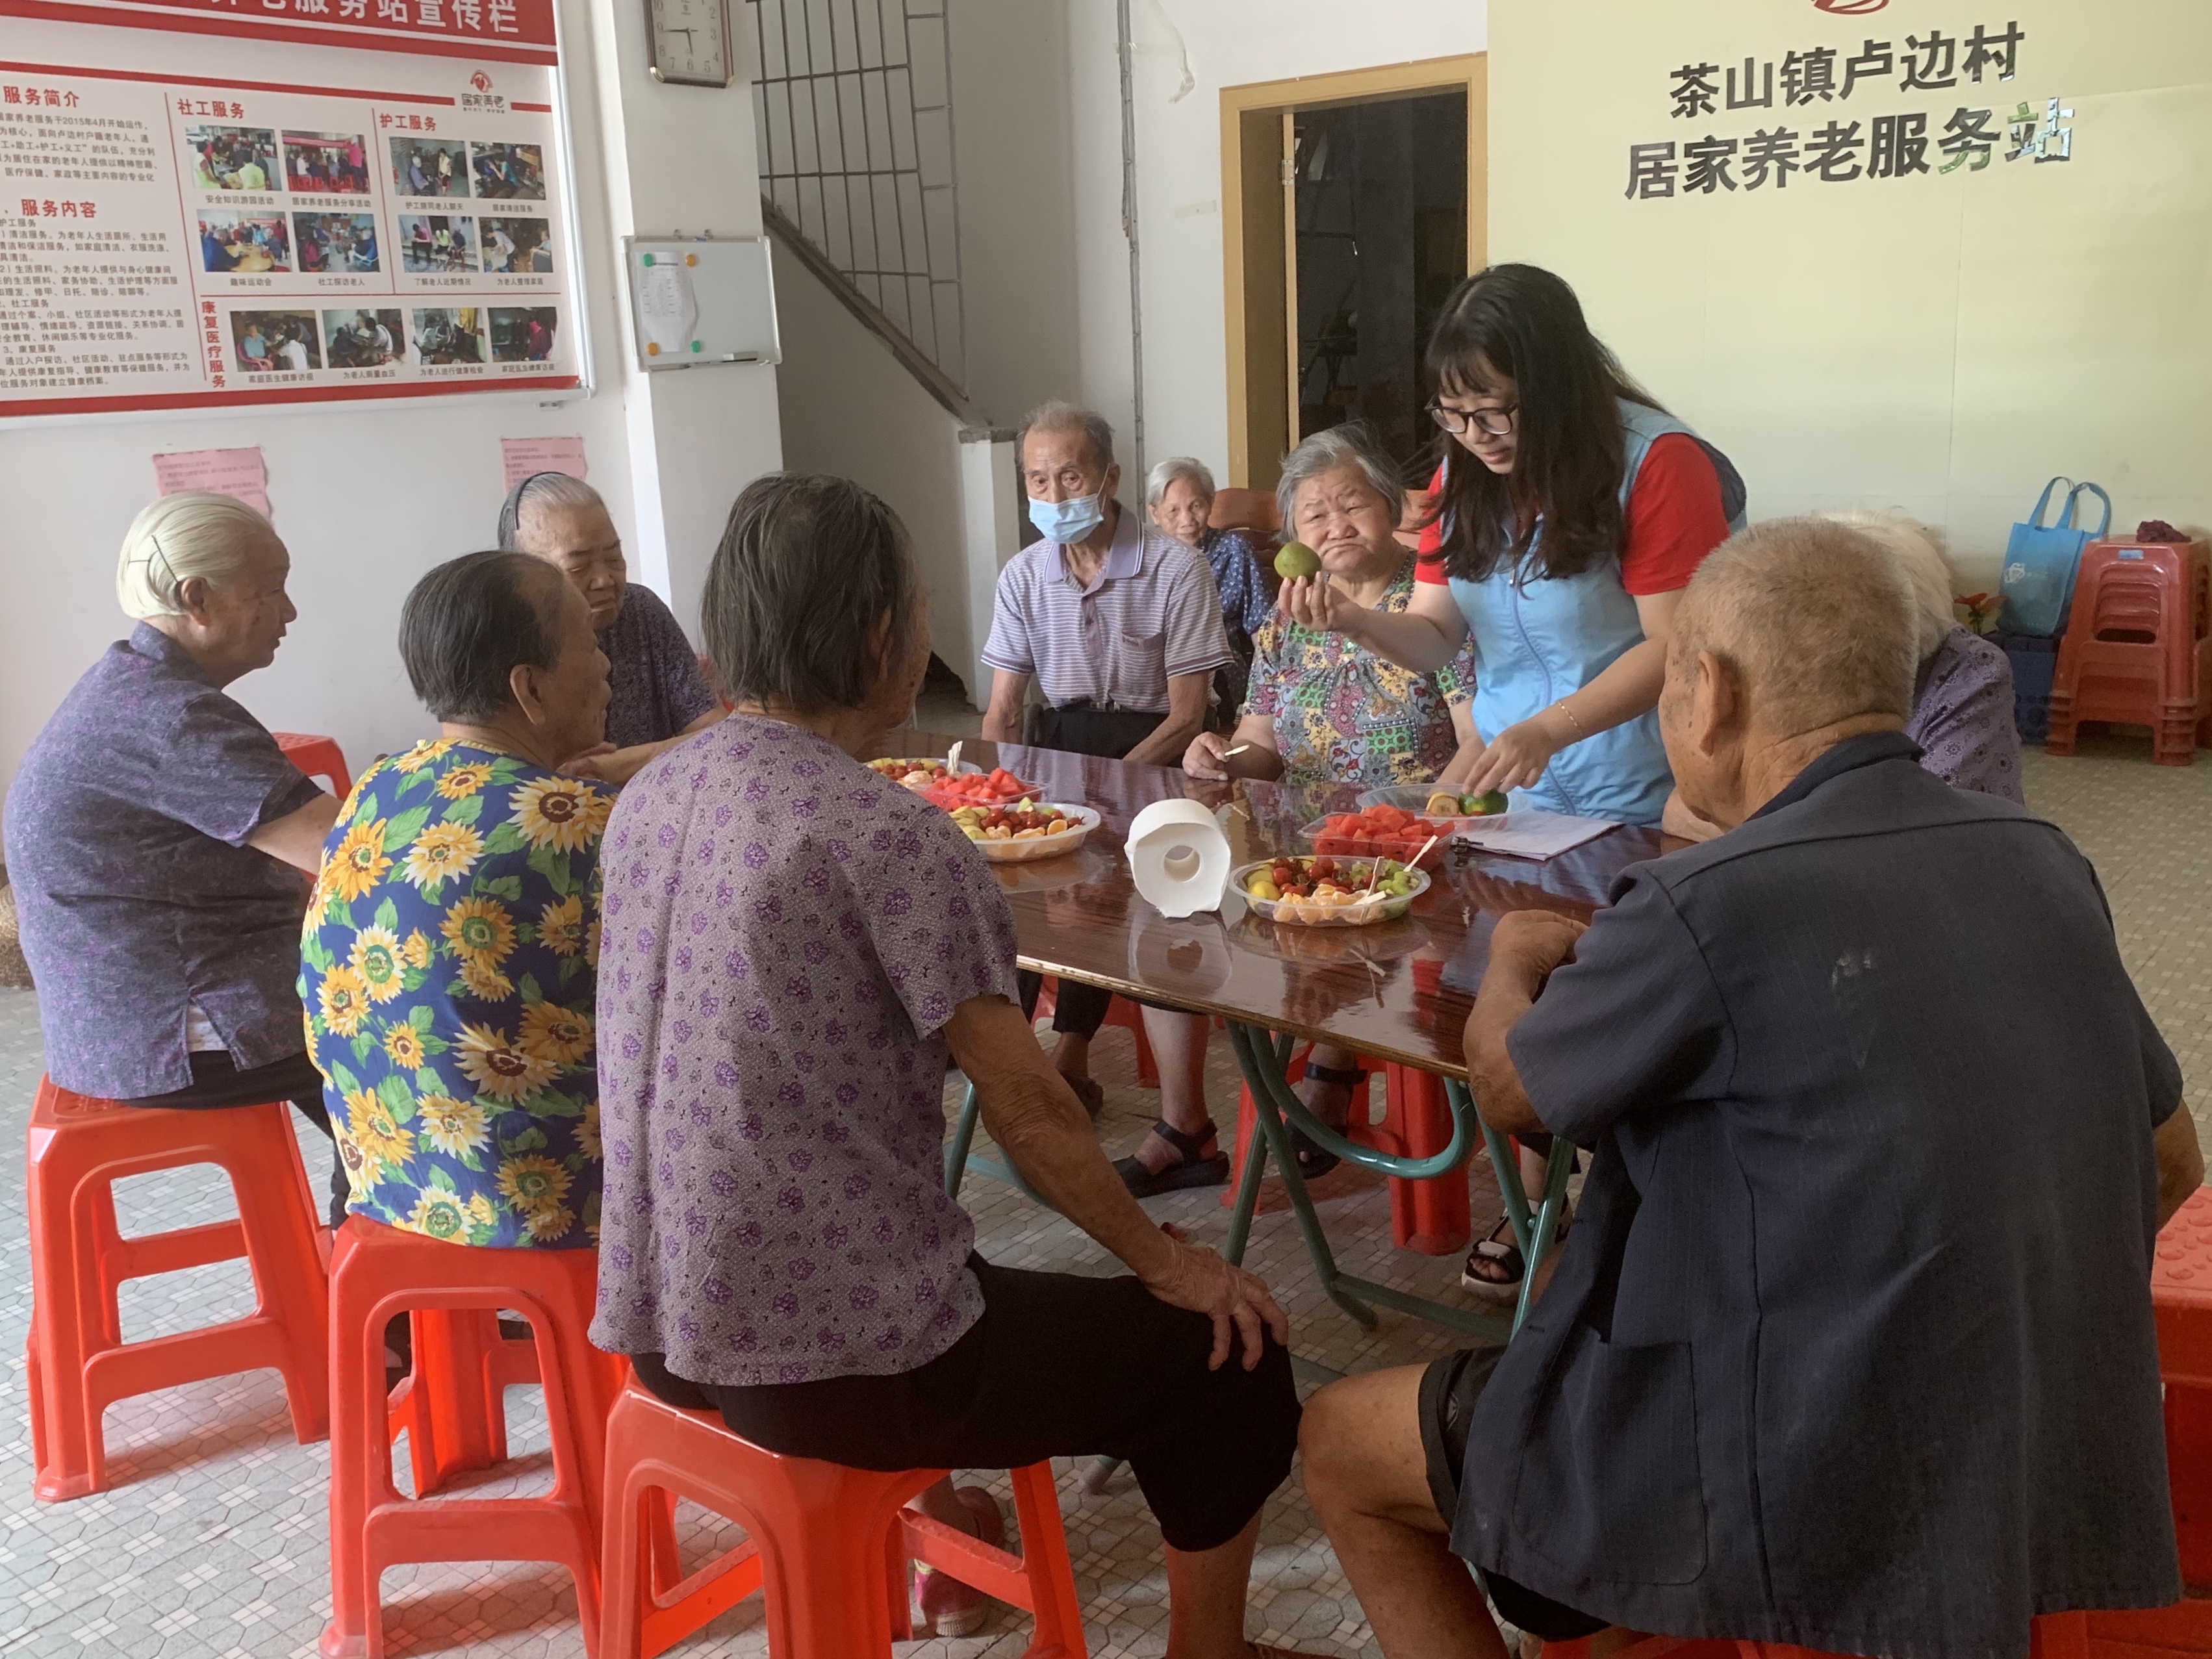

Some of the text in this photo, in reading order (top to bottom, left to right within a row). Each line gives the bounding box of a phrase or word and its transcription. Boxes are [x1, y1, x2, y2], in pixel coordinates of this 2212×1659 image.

[709, 6, 715, 19] 2
[657, 21, 663, 34] 9
[710, 28, 717, 40] 3
[659, 45, 665, 57] 8
[713, 52, 718, 62] 4
[670, 57, 676, 69] 7
[687, 58, 693, 71] 6
[704, 60, 711, 73] 5
[1669, 20, 2025, 119] 茶山镇卢边村
[3, 85, 79, 108] 服务简介
[177, 99, 244, 119] 社工服务
[380, 112, 436, 131] 护工服务
[1624, 97, 2075, 200] 居家养老服务站
[292, 197, 372, 208] 居家养老服务分享活动
[230, 277, 272, 287] 趣味运动会
[318, 277, 366, 287] 社工探访老人
[414, 277, 472, 286] 了解老人近期情况
[201, 301, 226, 388] 康复医疗服务
